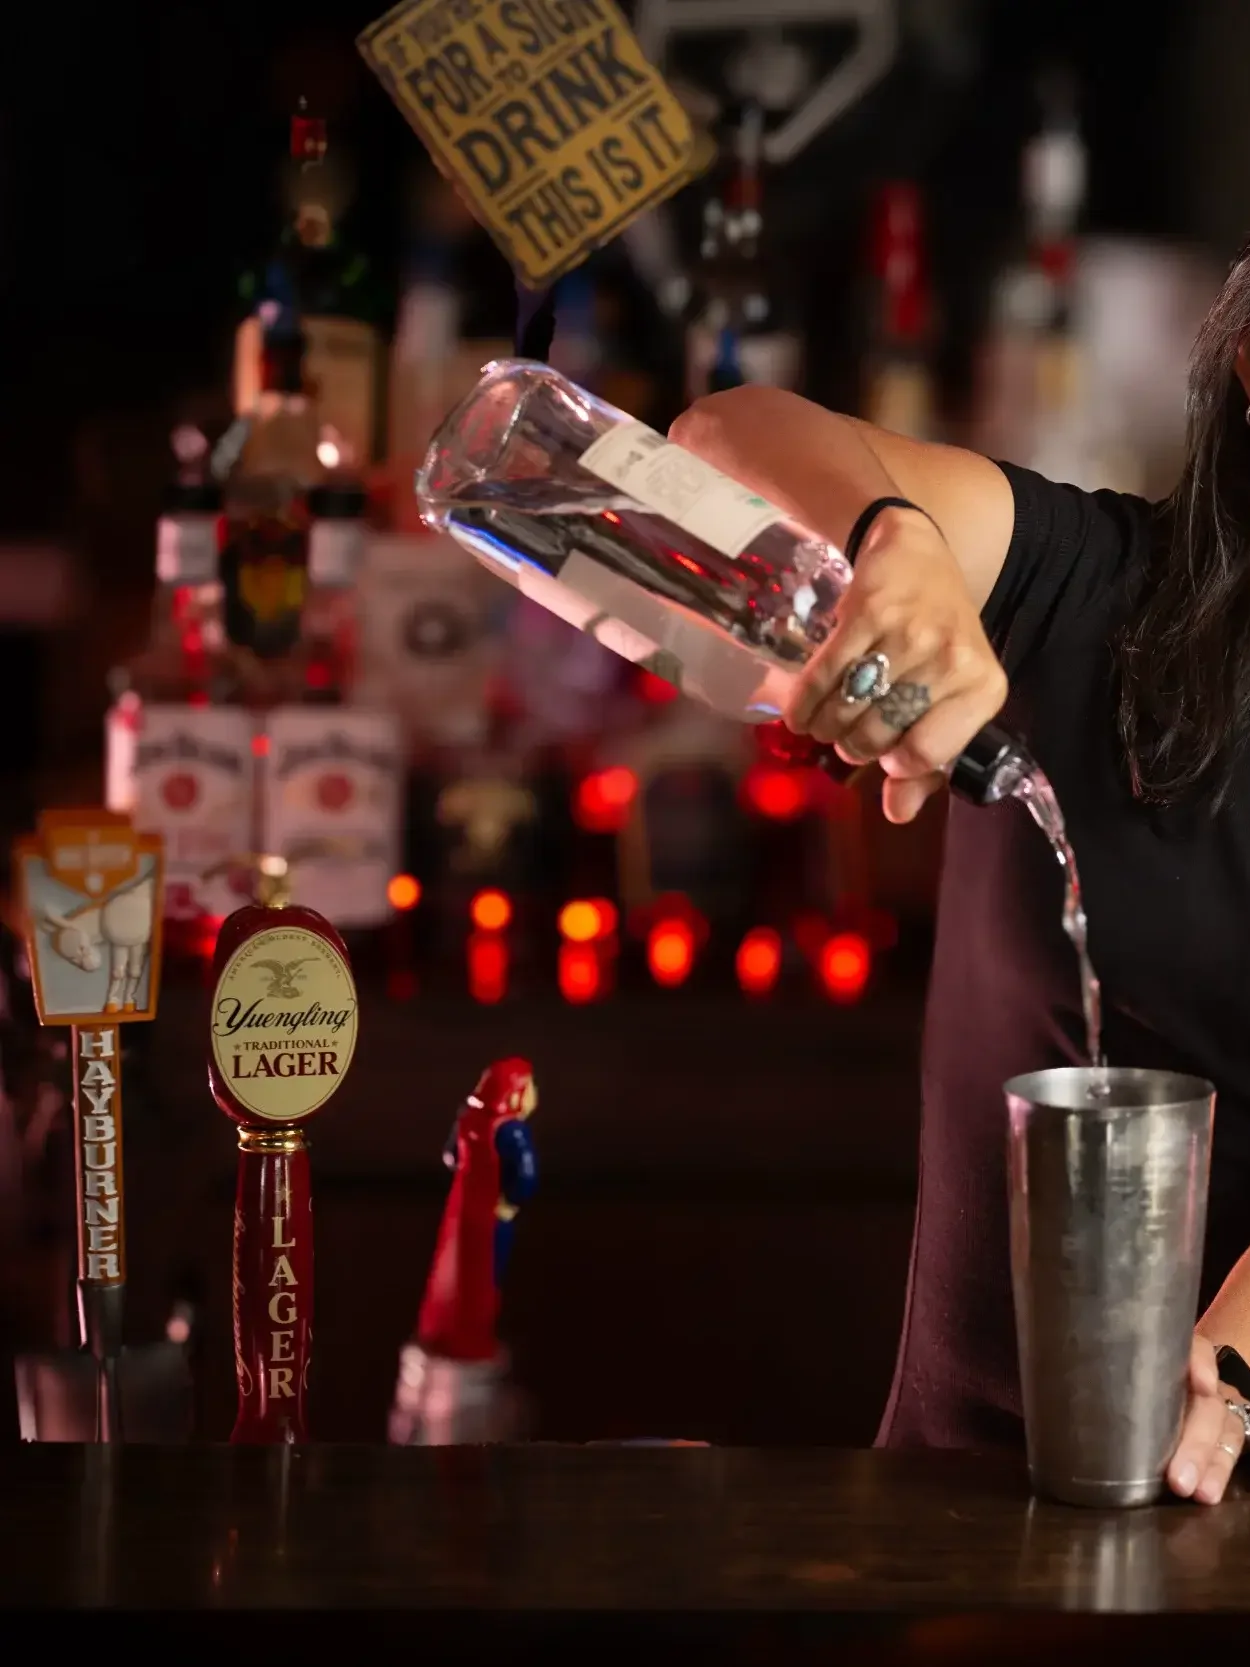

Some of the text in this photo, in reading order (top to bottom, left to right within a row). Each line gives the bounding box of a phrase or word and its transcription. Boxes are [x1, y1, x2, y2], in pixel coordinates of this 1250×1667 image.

[404, 41, 493, 138] FOR
[474, 22, 508, 66] A
[453, 26, 647, 197] DRINK
[492, 59, 530, 92] TO
[505, 102, 685, 262] THIS IS IT
[212, 997, 358, 1037] Yuengling
[231, 1051, 340, 1079] LAGER
[243, 1038, 330, 1051] TRADITIONAL
[79, 1030, 121, 1279] HAYBURNER
[268, 1216, 299, 1399] LAGER
